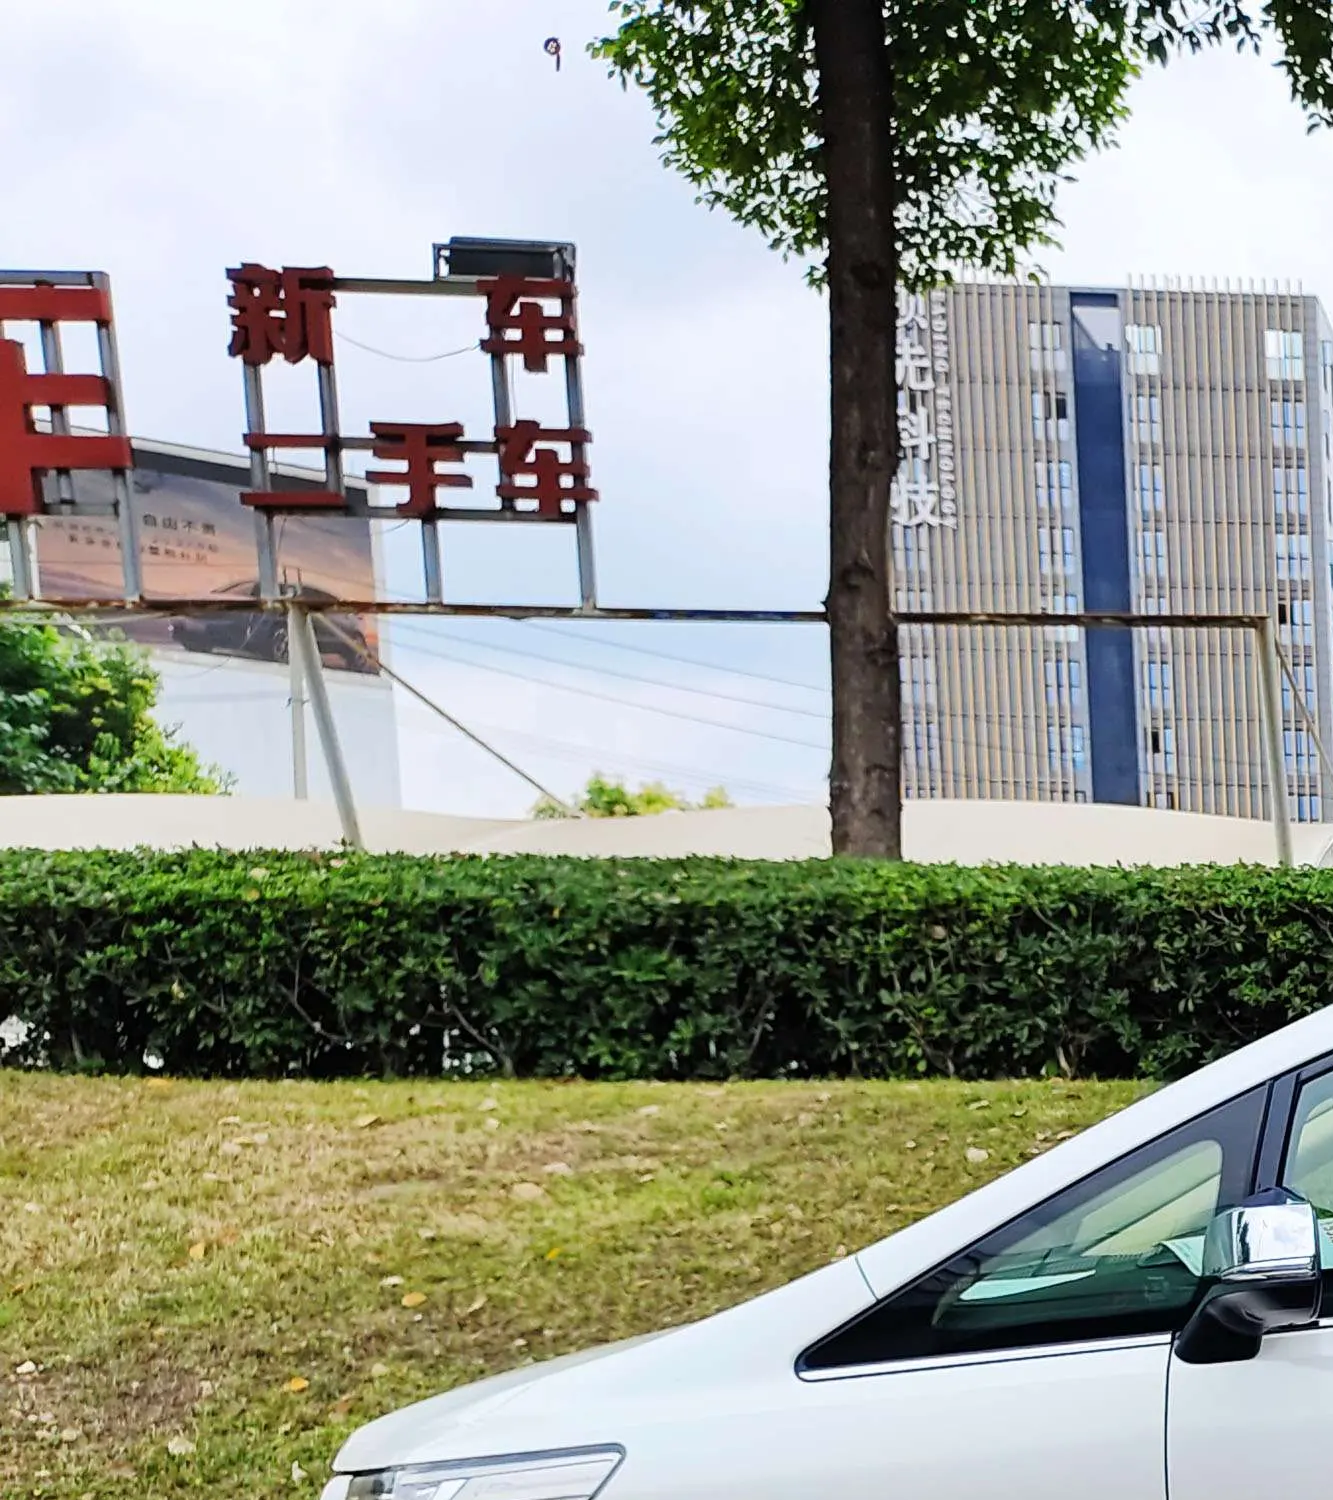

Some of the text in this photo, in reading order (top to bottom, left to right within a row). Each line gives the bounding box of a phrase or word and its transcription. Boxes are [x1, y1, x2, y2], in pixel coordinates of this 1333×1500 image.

[226, 262, 585, 373] 新车
[929, 280, 950, 374] EADING
[239, 420, 599, 520] 二手车
